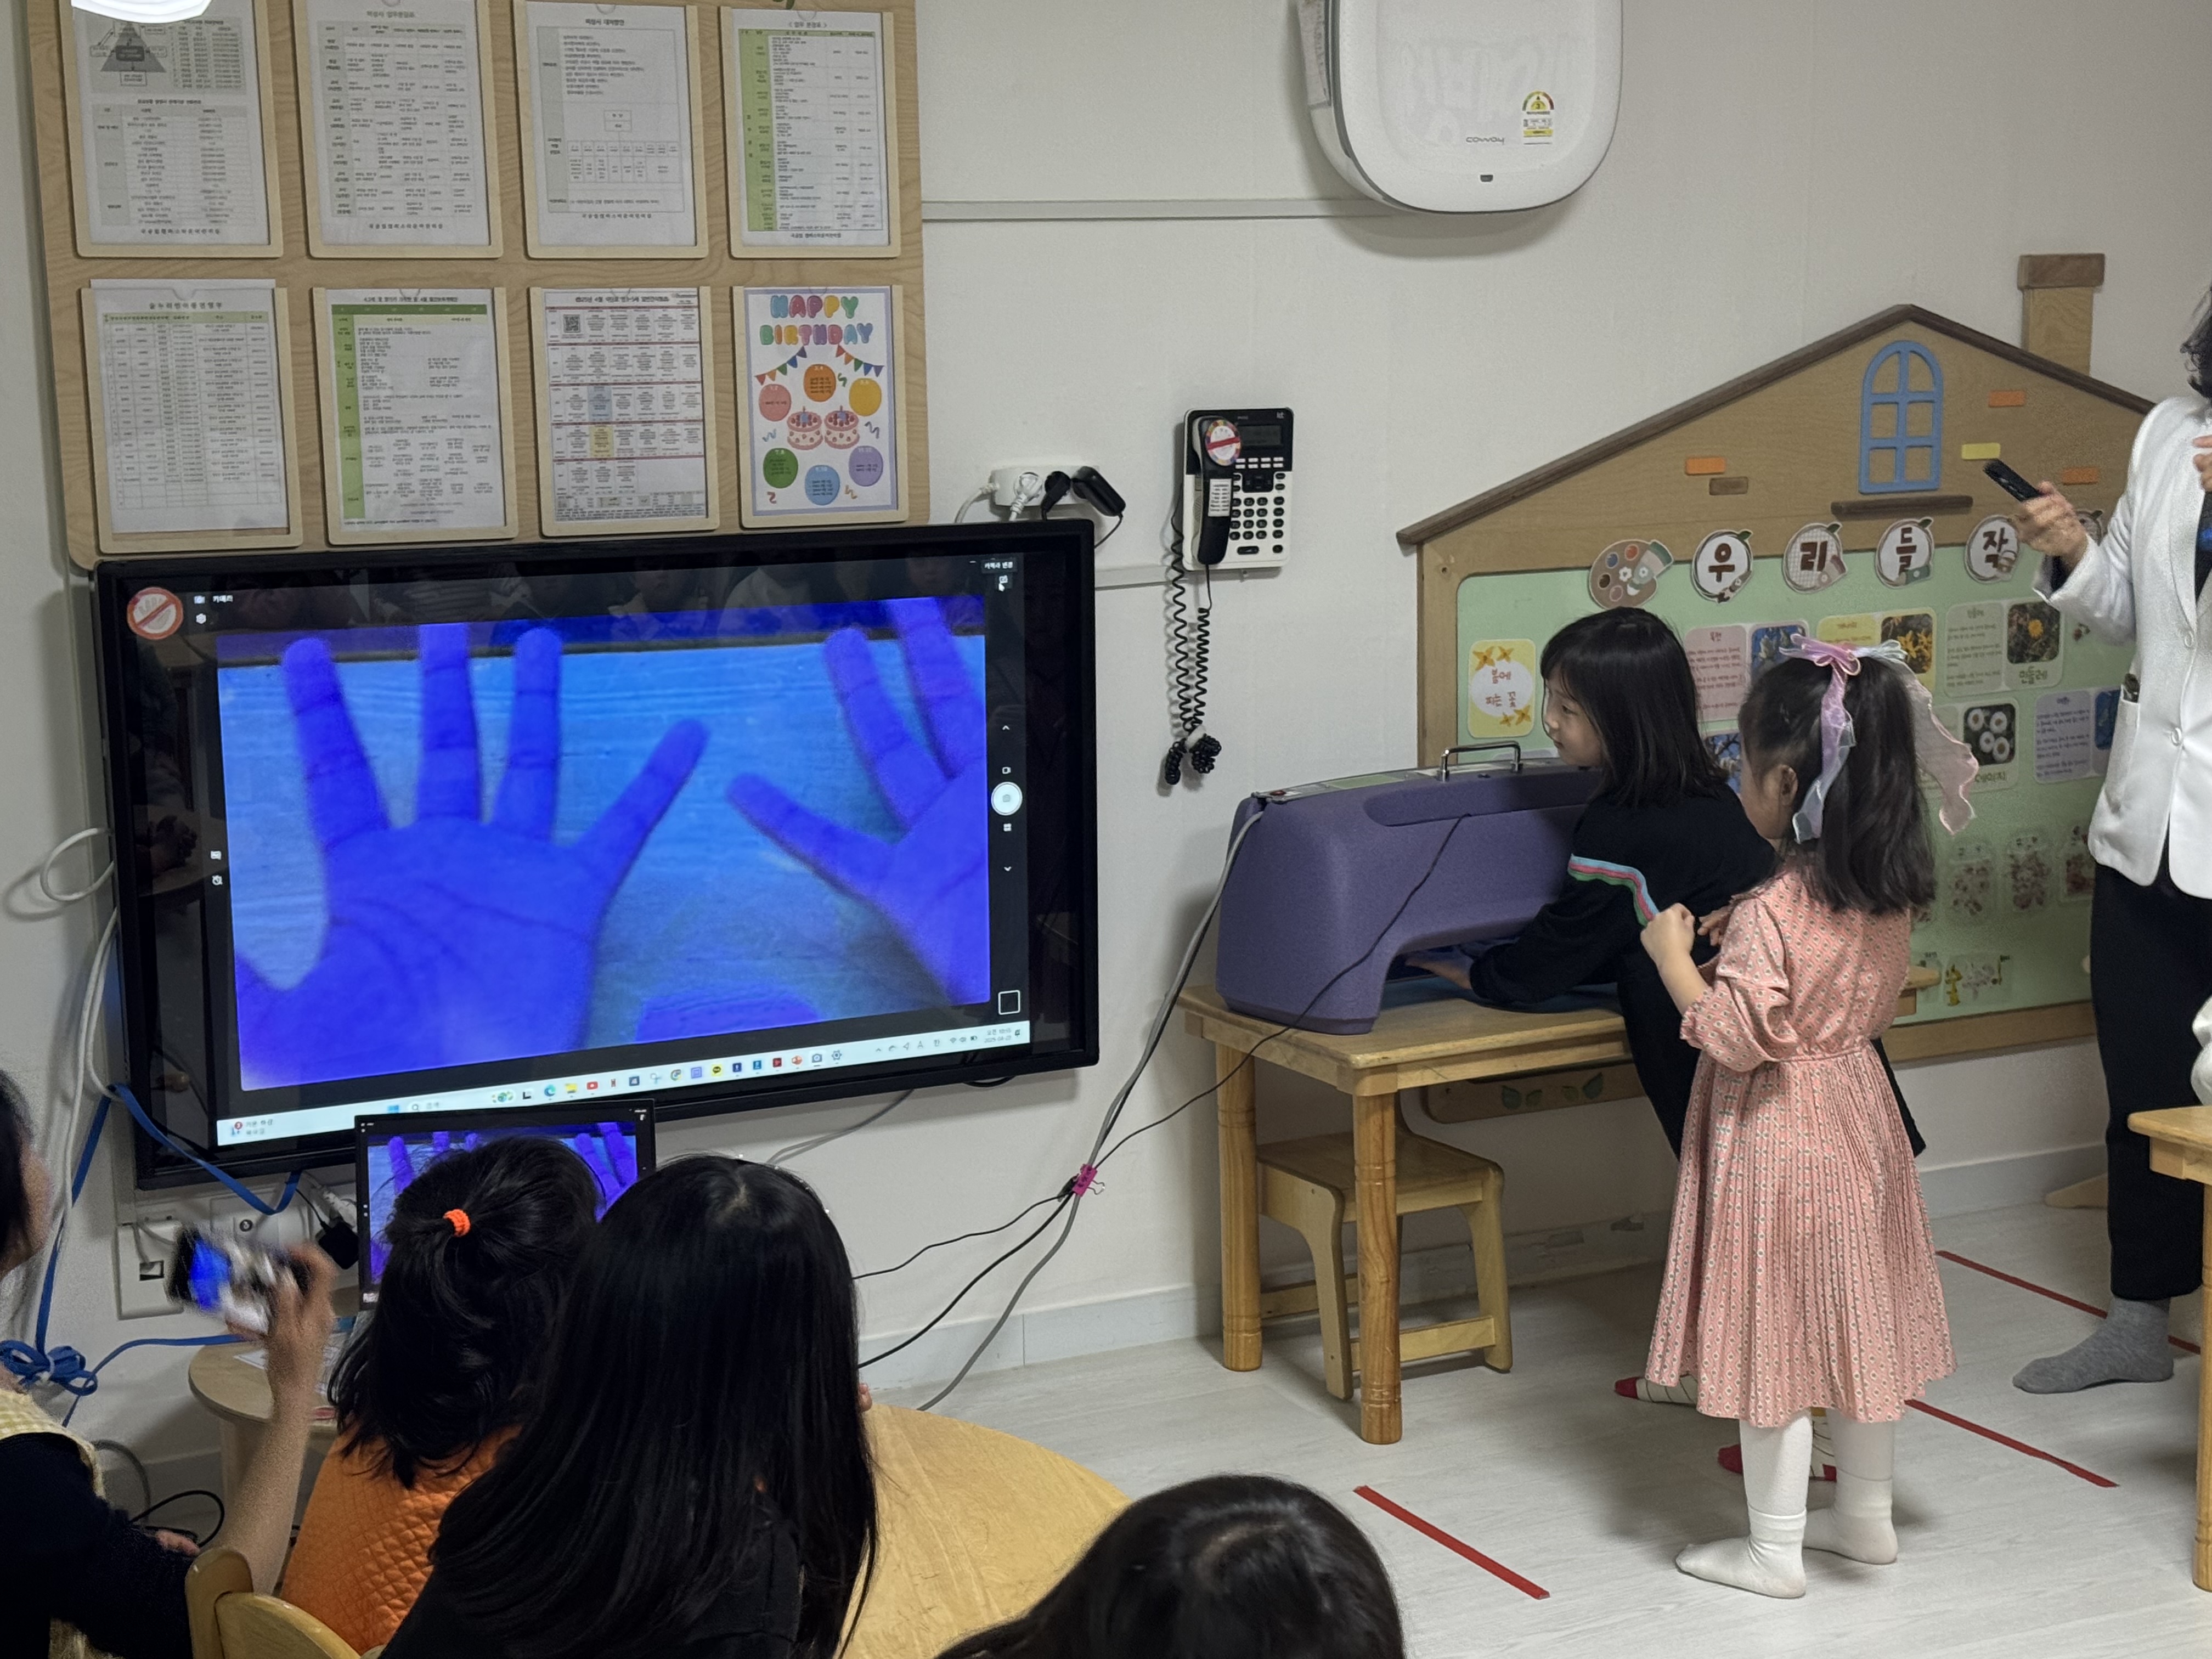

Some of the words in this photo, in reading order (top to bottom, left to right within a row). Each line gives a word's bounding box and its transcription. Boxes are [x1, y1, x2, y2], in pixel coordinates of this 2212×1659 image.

[771, 295, 858, 318] HAPPY
[760, 323, 873, 345] BIRTHDAY
[1708, 543, 1735, 583] 우
[1800, 540, 1827, 572] 리
[1491, 668, 1511, 684] 봄에
[2019, 666, 2047, 684] 민들레
[1507, 691, 1516, 708] 꽃
